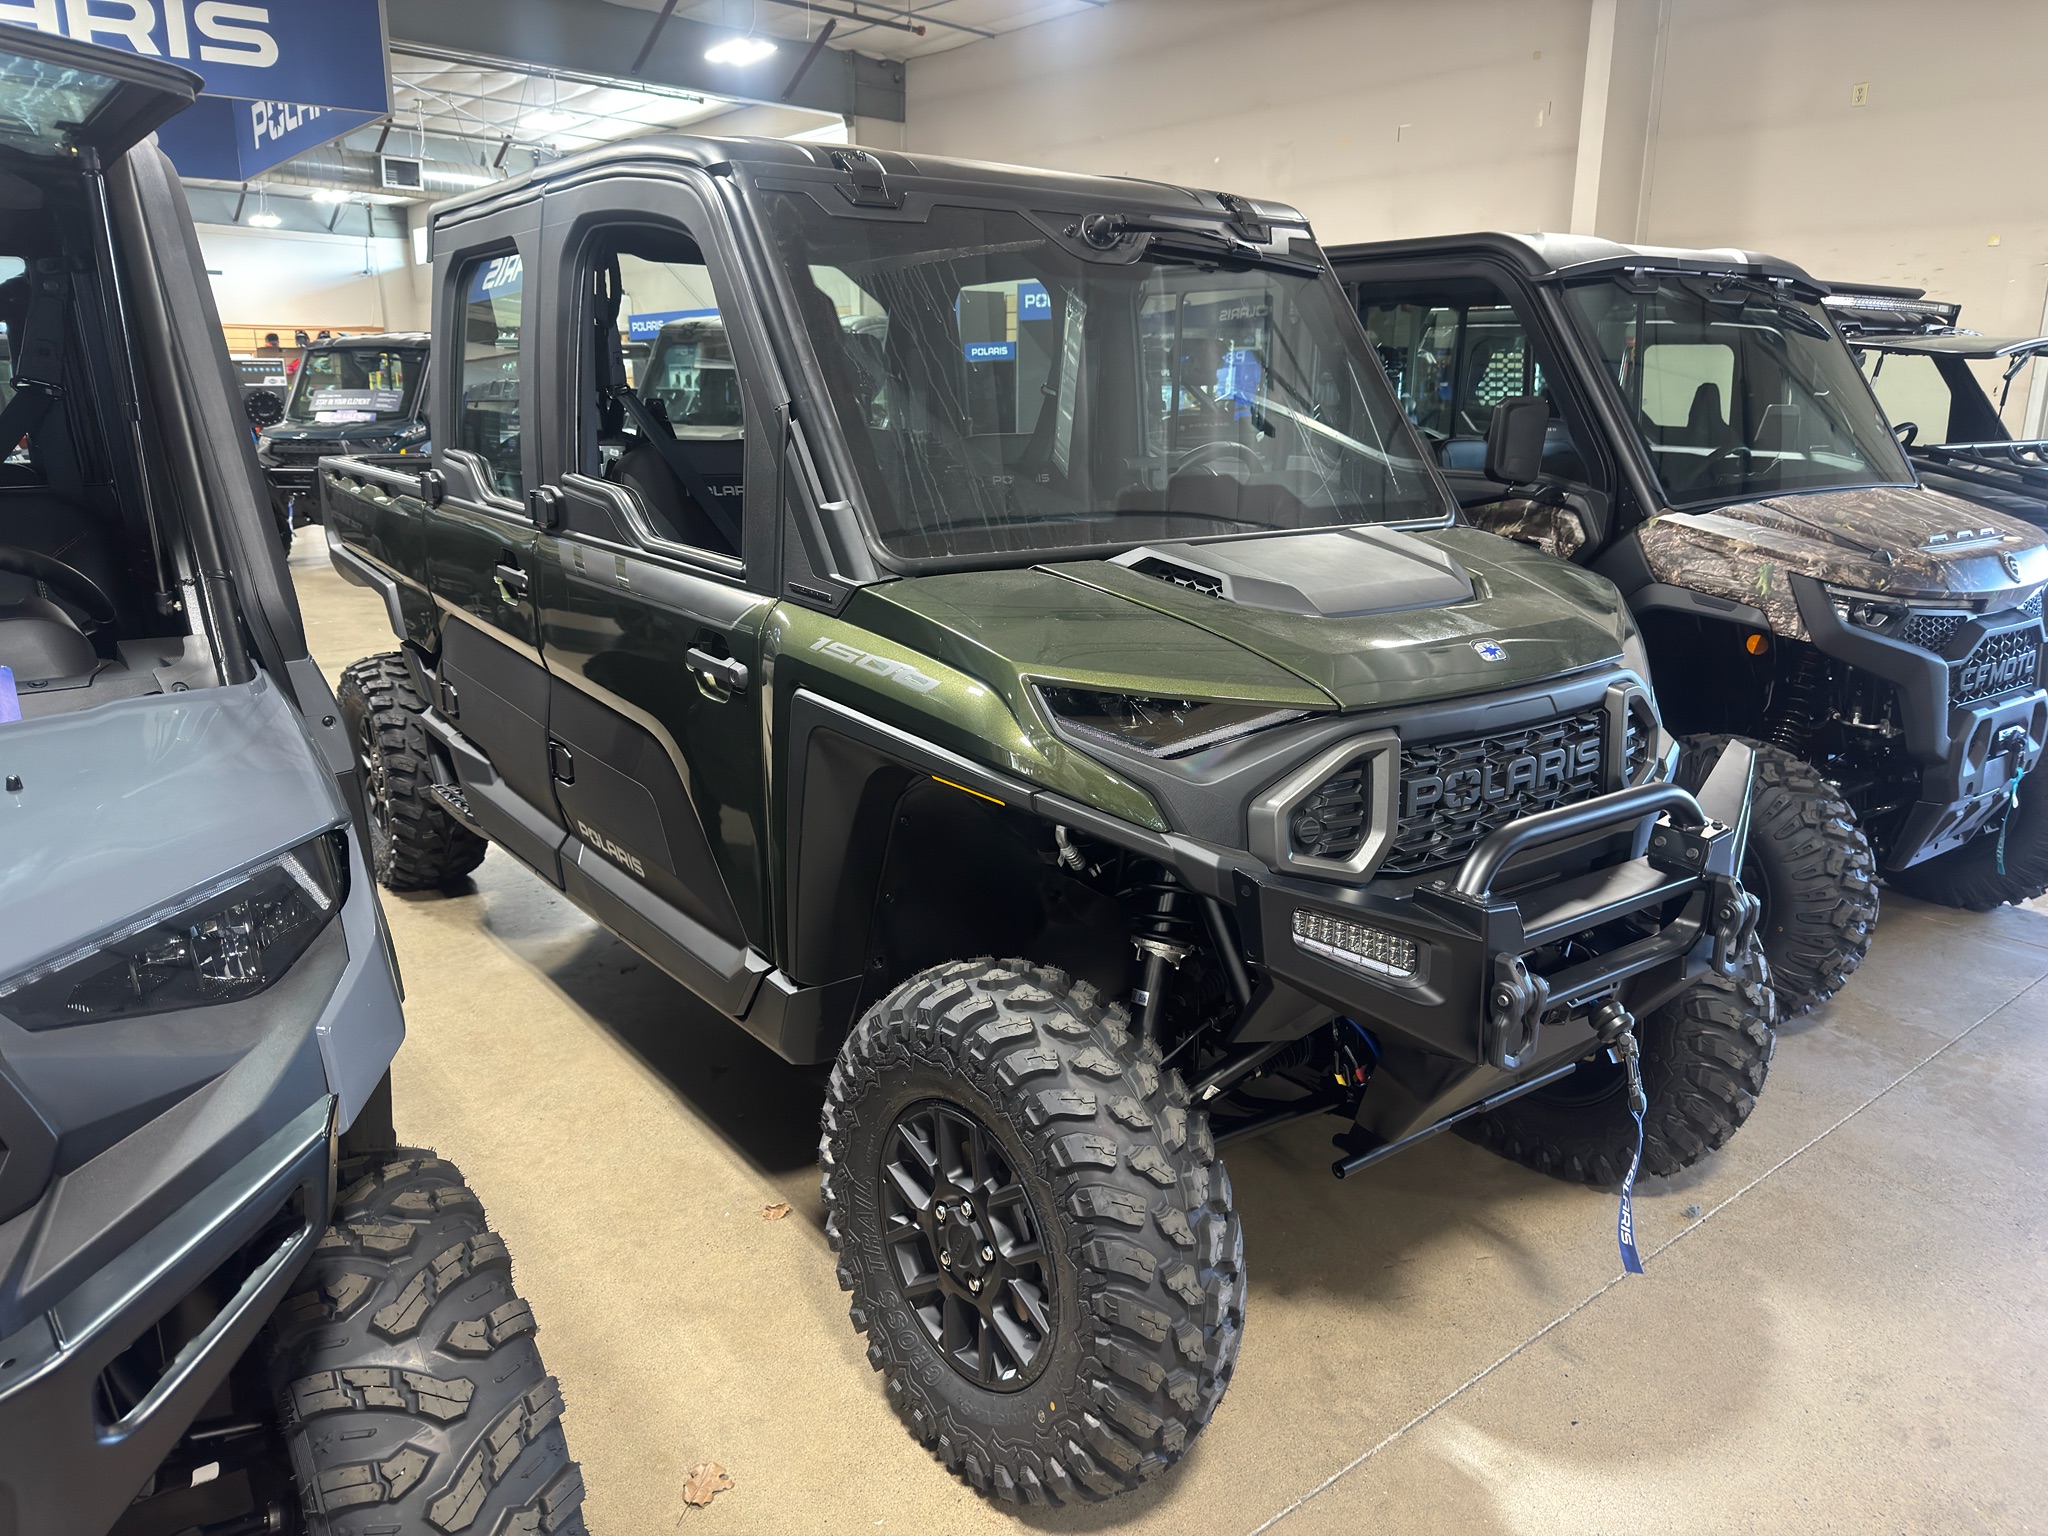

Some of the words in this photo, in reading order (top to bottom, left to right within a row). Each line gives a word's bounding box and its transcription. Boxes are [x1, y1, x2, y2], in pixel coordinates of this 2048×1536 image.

[251, 101, 332, 150] POL
[971, 346, 1008, 356] POLARIS
[1961, 650, 2037, 692] CFMOTO
[1407, 736, 1600, 818] POLARIS
[577, 820, 646, 878] POLARIS
[854, 1176, 887, 1275] TRAIL
[1620, 1153, 1638, 1246] POLARIS
[878, 1289, 945, 1387] CROSS
